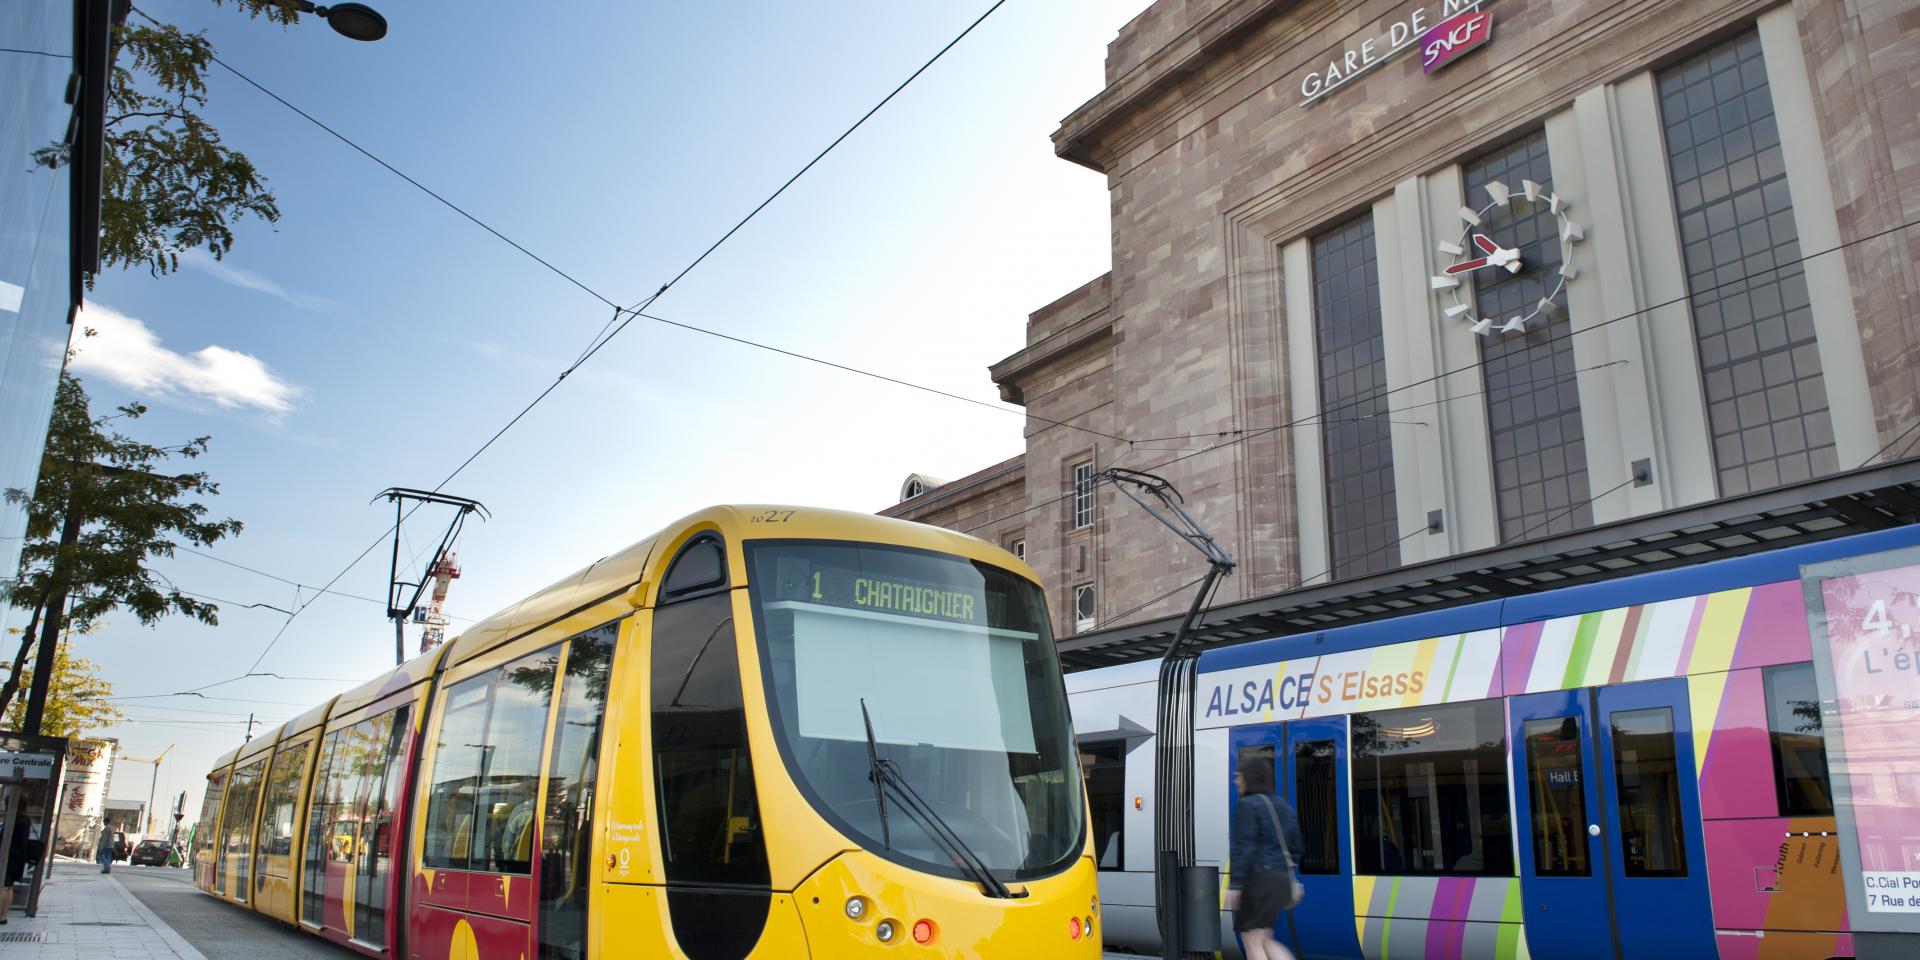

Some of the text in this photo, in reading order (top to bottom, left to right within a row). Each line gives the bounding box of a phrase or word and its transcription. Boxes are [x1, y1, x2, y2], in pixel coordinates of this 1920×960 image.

[1301, 38, 1374, 97] GARE
[1390, 7, 1427, 48] DE
[1423, 14, 1485, 67] SNCF
[812, 571, 975, 620] 1 CHATAIGNIER
[1205, 672, 1313, 718] ALSACE
[1550, 770, 1571, 783] Hall
[1774, 842, 1790, 876] Kruth
[1866, 877, 1899, 889] C.Cial
[1869, 895, 1877, 906] 7
[1881, 895, 1905, 907] Rue
